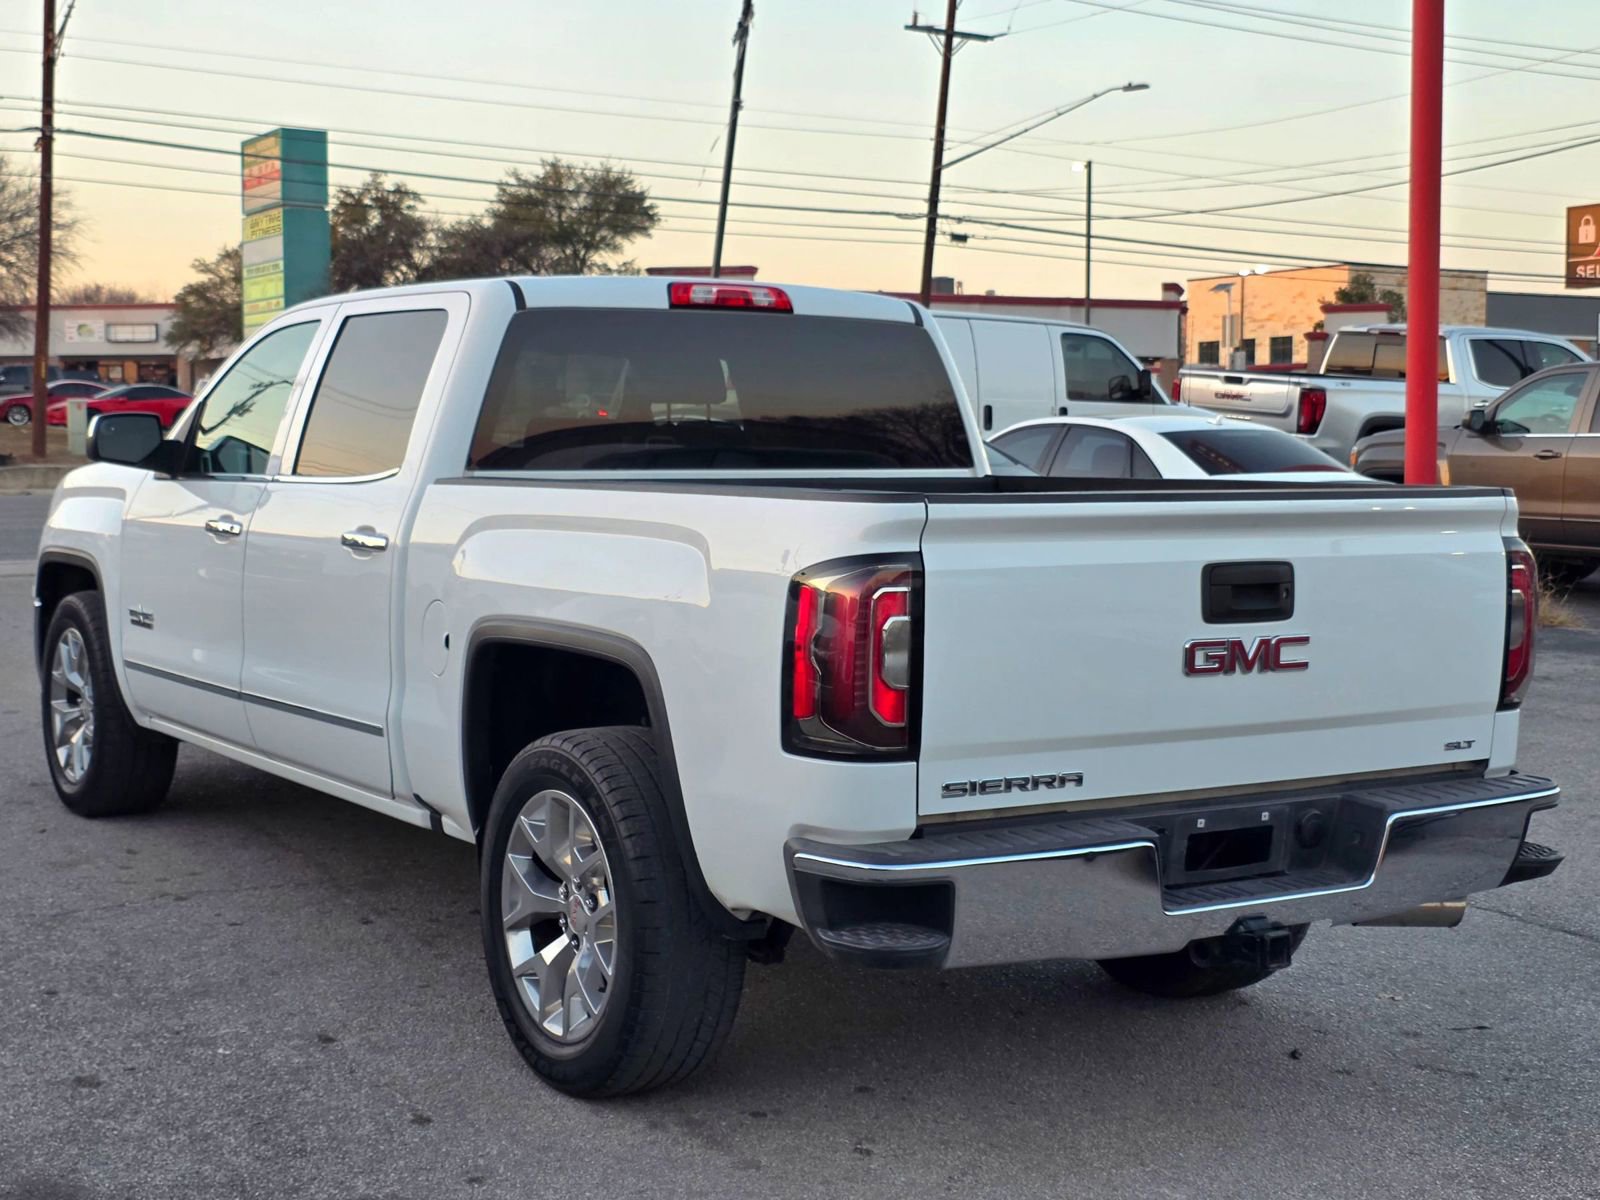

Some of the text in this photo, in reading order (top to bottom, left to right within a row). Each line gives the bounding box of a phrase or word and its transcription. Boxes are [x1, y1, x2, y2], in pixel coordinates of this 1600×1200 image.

[1183, 635, 1310, 677] GMC
[1443, 740, 1476, 751] SLT
[528, 756, 584, 786] EAGLE
[941, 770, 1084, 799] SIERRA
